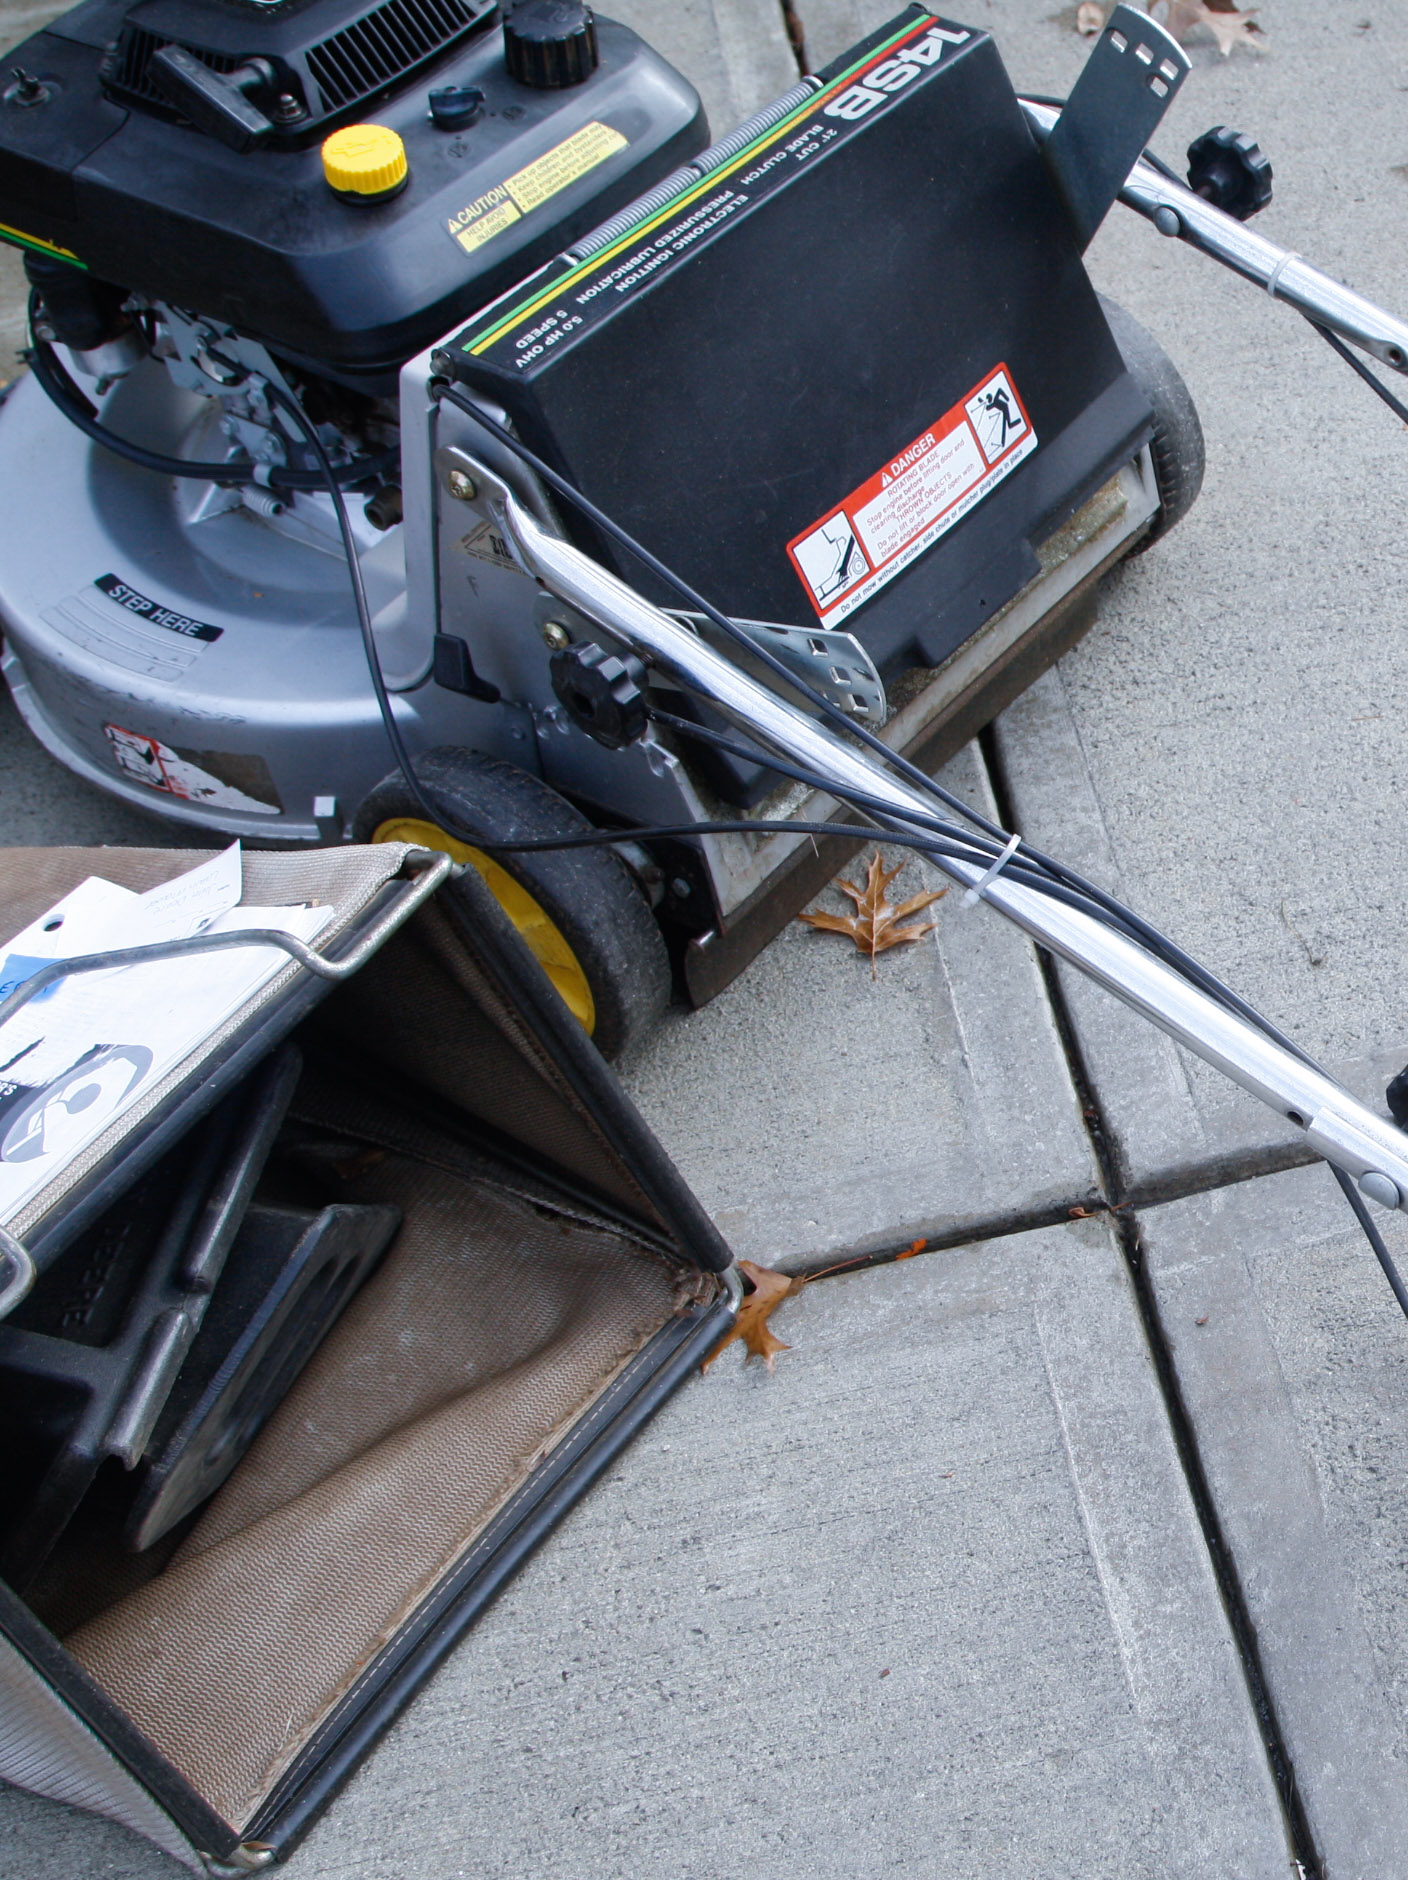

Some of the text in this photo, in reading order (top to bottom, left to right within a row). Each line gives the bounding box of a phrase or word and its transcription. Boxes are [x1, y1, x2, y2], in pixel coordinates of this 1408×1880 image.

[823, 27, 971, 120] 14SB
[740, 124, 824, 185] BLADE CLUTCH
[795, 142, 820, 161] CUT
[457, 185, 508, 224] CAUTION
[466, 207, 506, 237] HELP AVOID
[477, 218, 508, 242] INJURIES
[575, 190, 734, 304] PRESSURIZED LUBRICATION
[615, 194, 749, 292] ELECTRONIC IGNITION
[515, 309, 568, 349] 5 SPEED
[515, 315, 583, 368] 5.0 HP OHV
[887, 450, 940, 497] ROTATING BLADE
[890, 433, 936, 476] DANGER
[867, 438, 965, 526] Stop engine before lifting door and
[877, 540, 887, 550] Do
[888, 529, 899, 541] not
[899, 521, 908, 532] lift
[909, 515, 915, 523] or
[916, 500, 933, 517] block
[933, 487, 946, 502] door
[947, 474, 962, 490] open
[962, 463, 975, 476] with
[896, 472, 952, 522] THROWN OBJECTS
[840, 603, 850, 613] Do
[851, 593, 862, 605] not
[862, 581, 877, 596] mow
[877, 561, 899, 582] without
[923, 531, 934, 544] side
[935, 517, 950, 532] chute
[951, 510, 957, 519] or
[958, 491, 978, 512] mulcher
[1009, 449, 1023, 465] place
[871, 486, 925, 534] clearing discharge
[881, 517, 925, 558] blade engaged
[107, 584, 204, 636] STEP HERE
